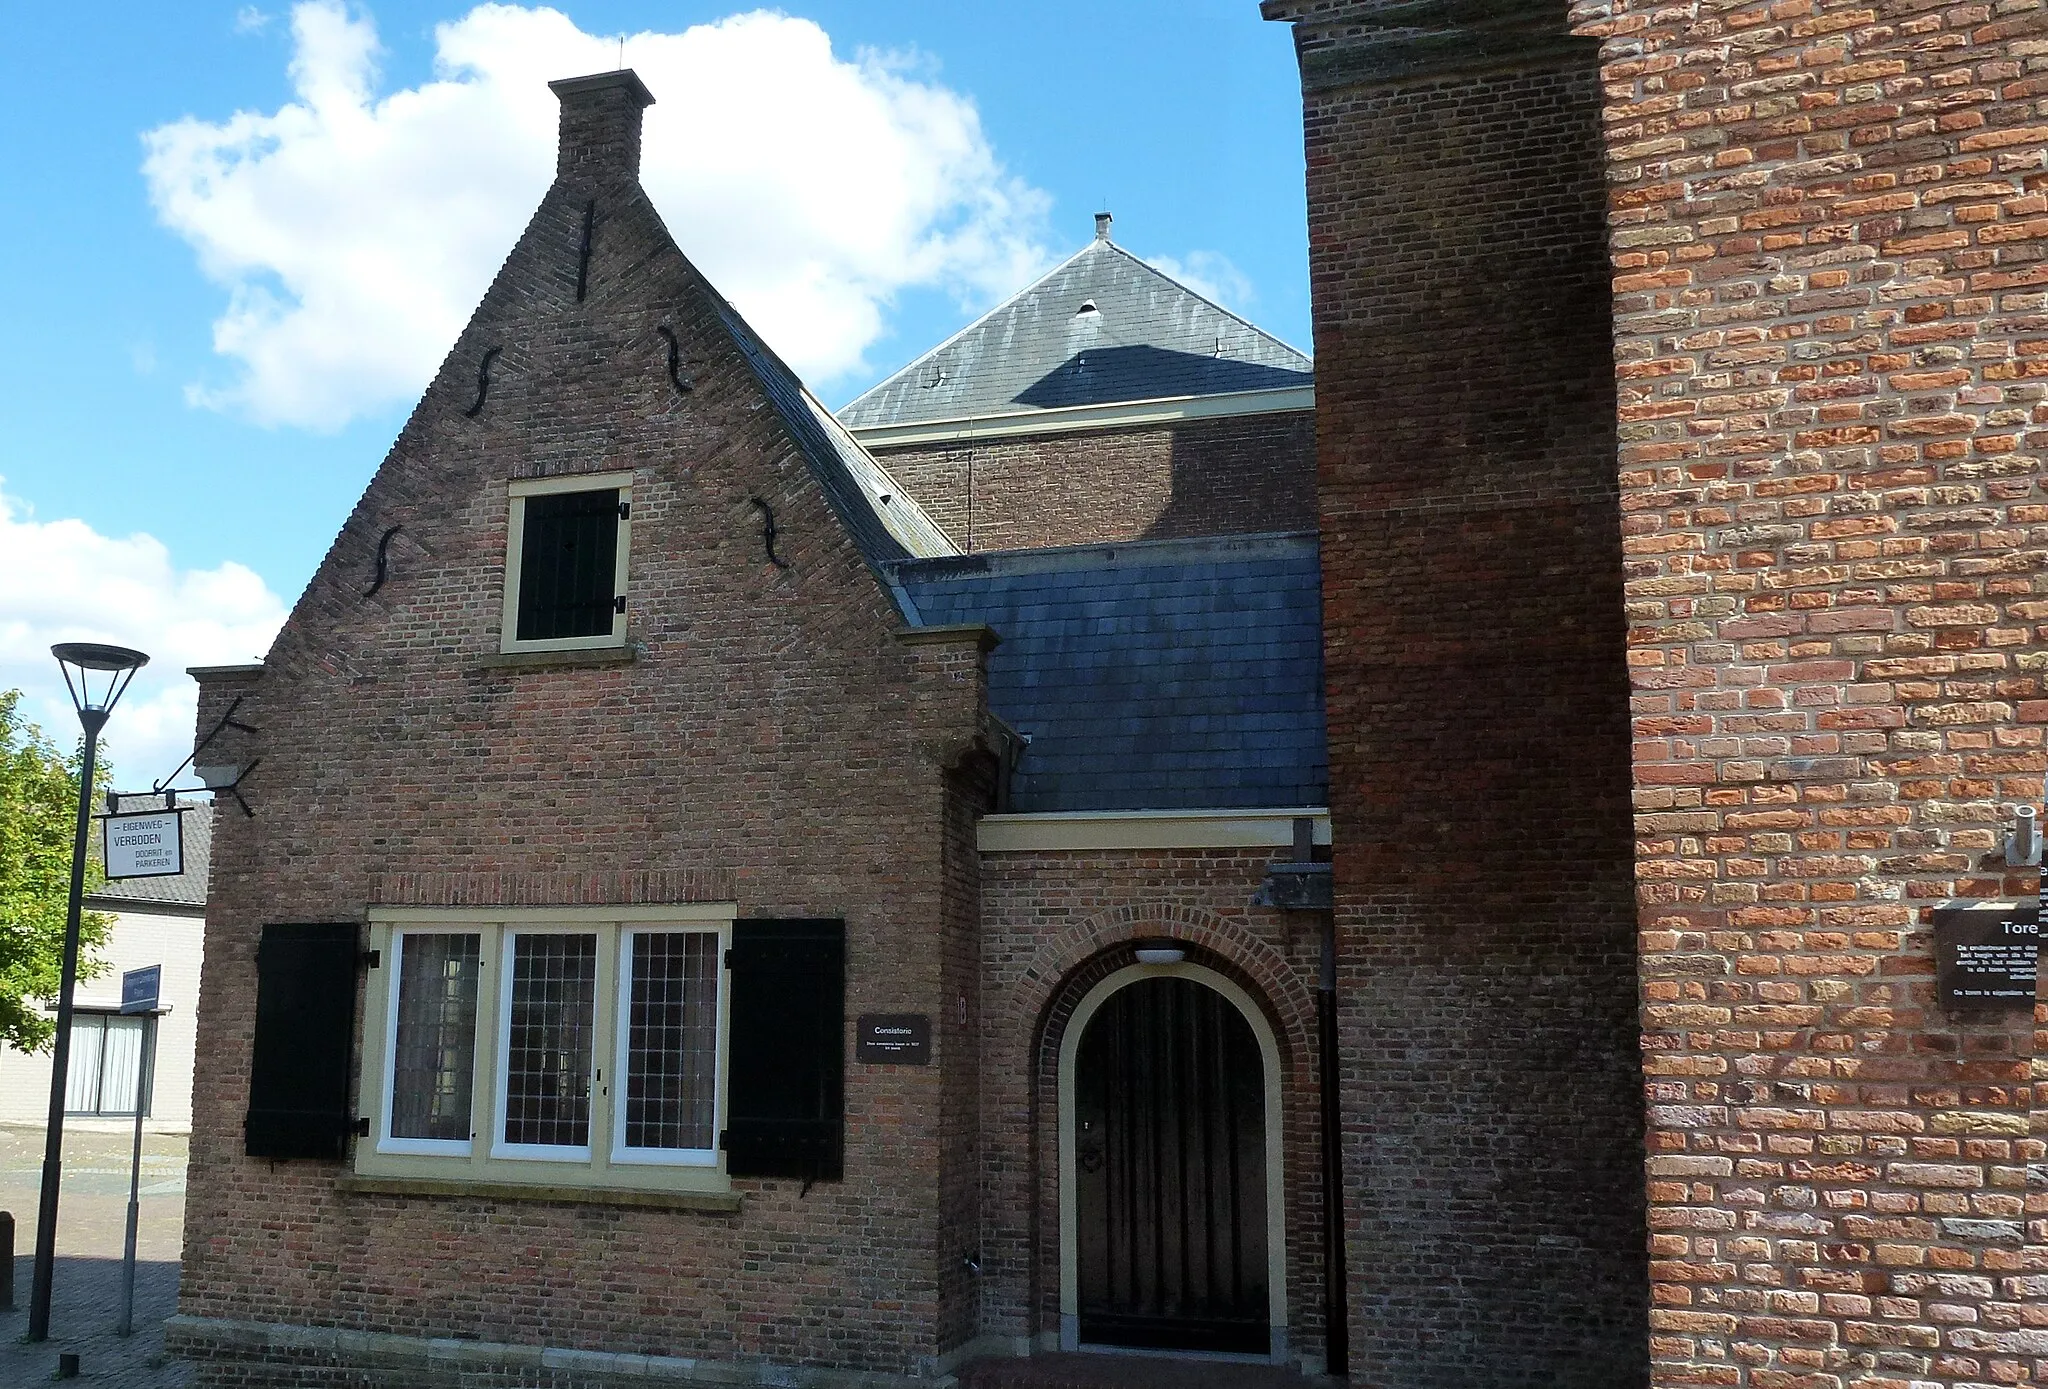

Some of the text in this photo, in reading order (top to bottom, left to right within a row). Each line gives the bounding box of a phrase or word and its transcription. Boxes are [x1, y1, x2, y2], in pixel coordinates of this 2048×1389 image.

[123, 820, 162, 831] EIGENWEG
[114, 834, 161, 846] VERBODEN
[136, 858, 170, 868] PARKEREN
[874, 1026, 912, 1034] Consistorie
